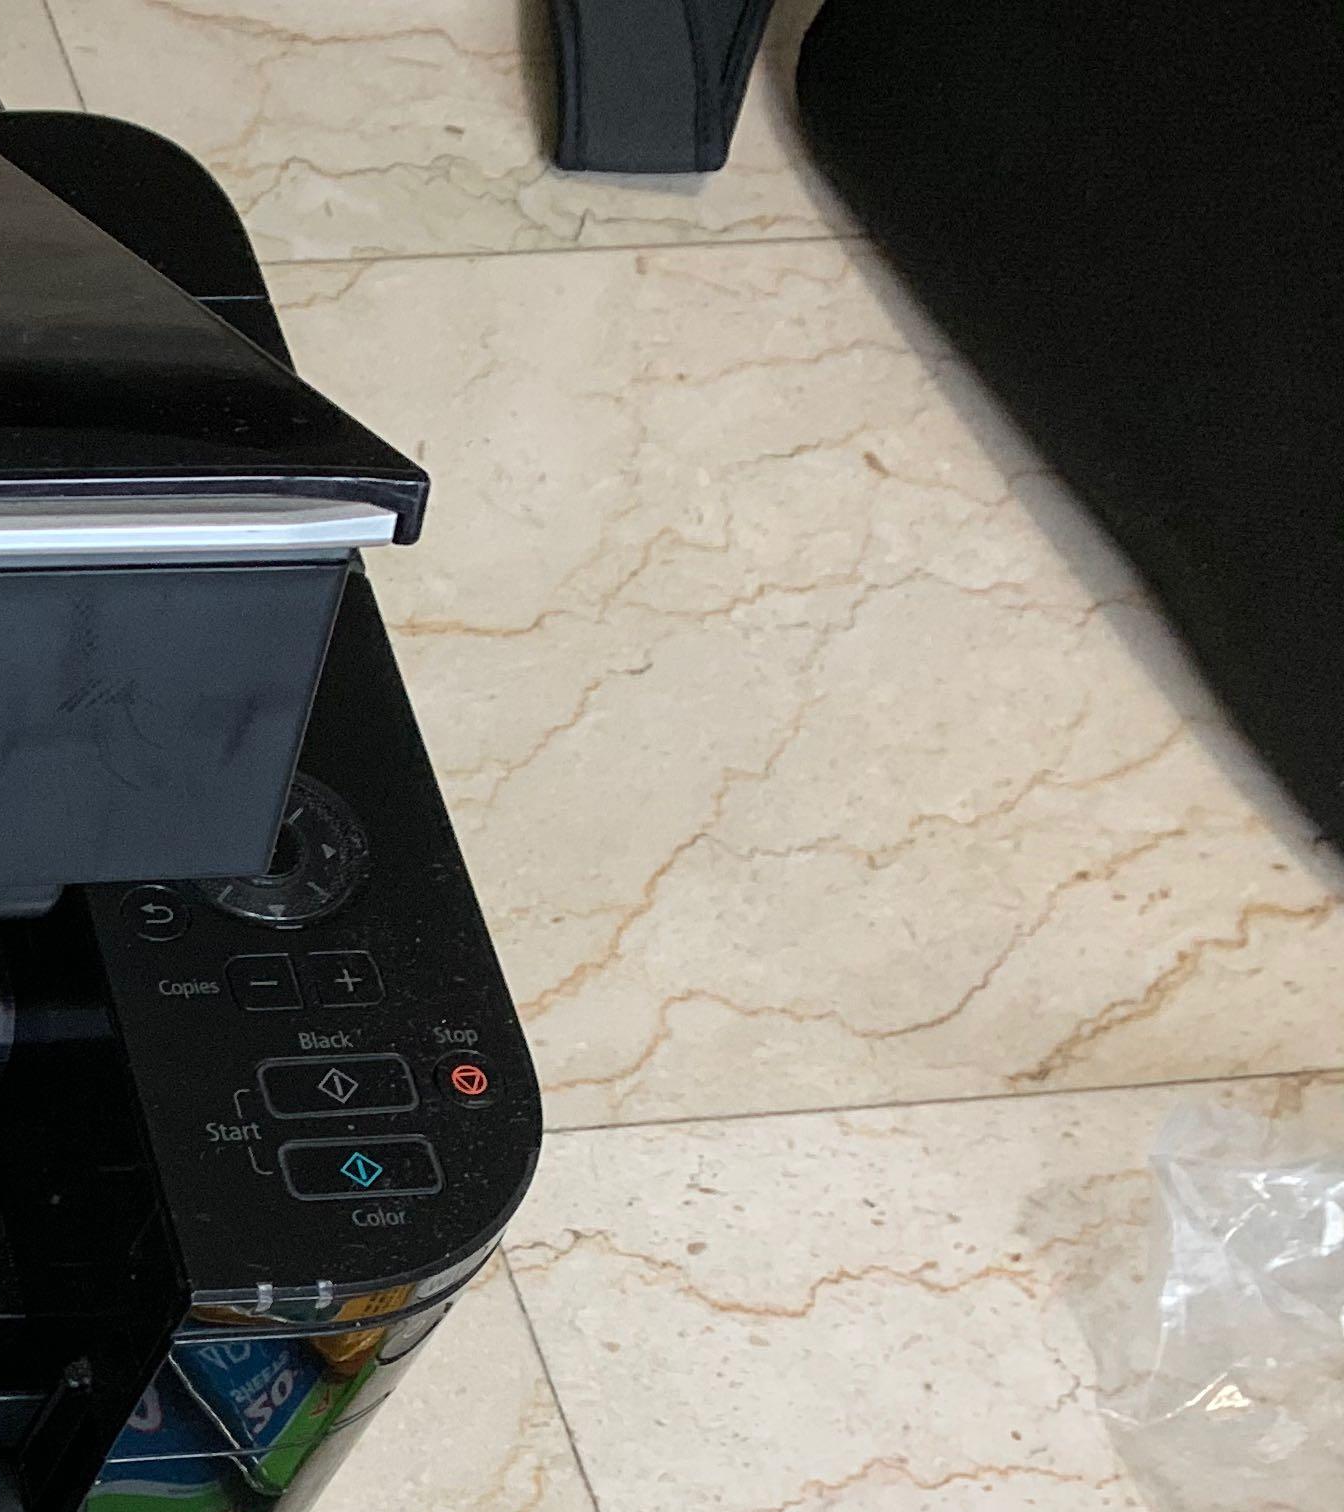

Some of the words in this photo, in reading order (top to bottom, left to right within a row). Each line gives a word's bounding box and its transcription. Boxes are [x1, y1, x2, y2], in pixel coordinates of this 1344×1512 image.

[158, 979, 220, 998] Copies
[298, 1031, 353, 1050] Black
[433, 1026, 479, 1046] Stop
[205, 1121, 262, 1142] Start
[351, 1208, 407, 1227] Color
